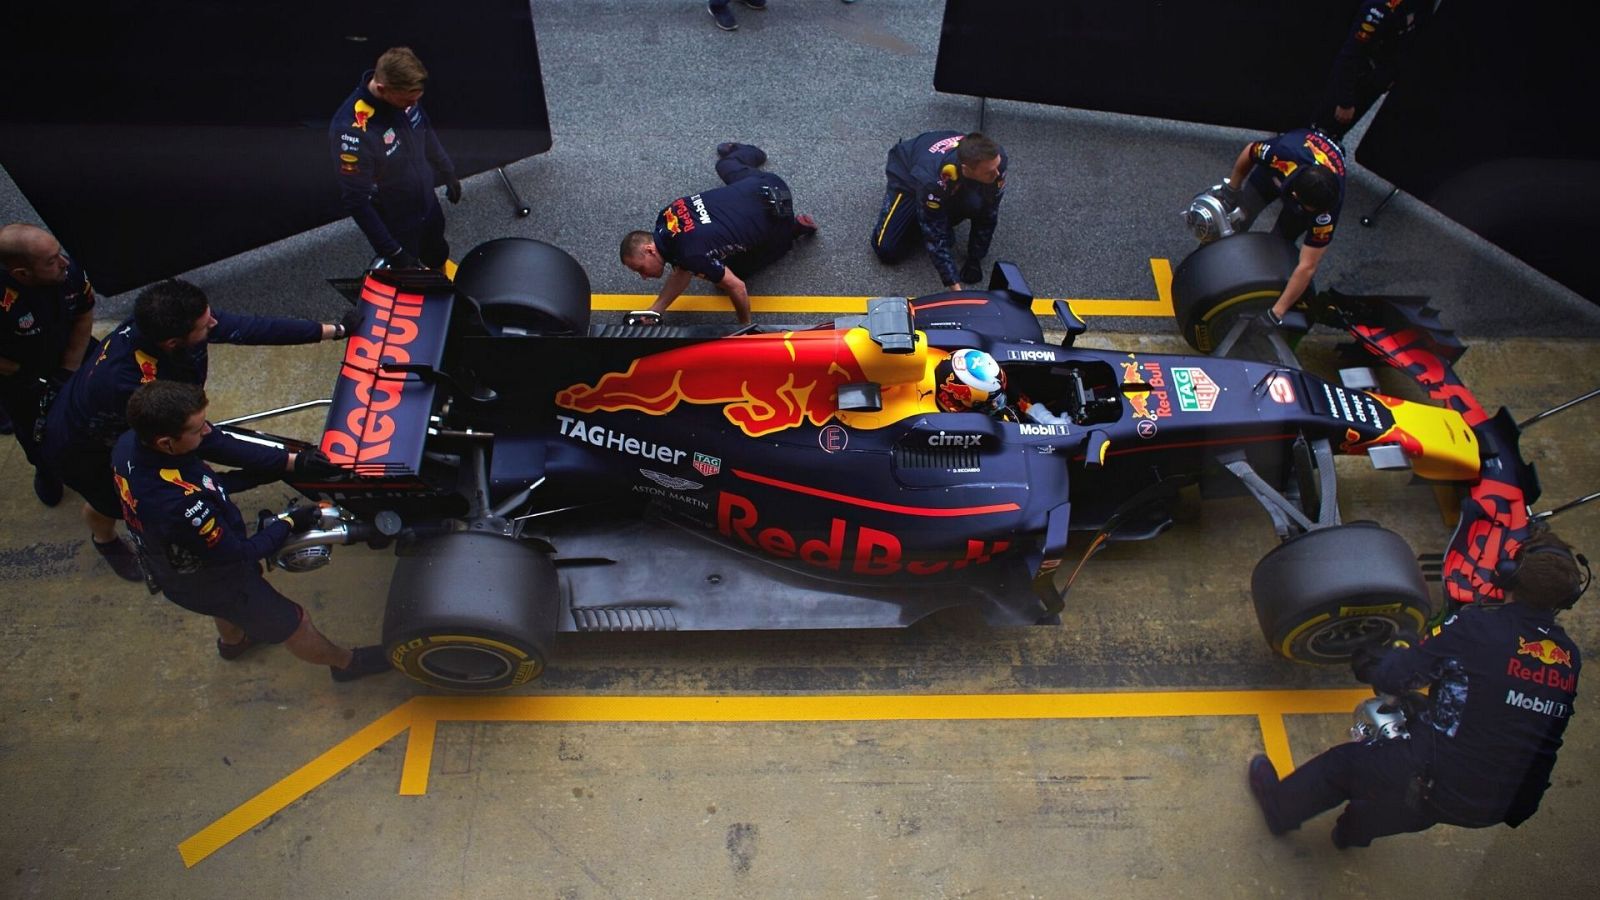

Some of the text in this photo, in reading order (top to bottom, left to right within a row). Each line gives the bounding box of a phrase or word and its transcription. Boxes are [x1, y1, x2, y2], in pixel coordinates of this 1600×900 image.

[692, 199, 711, 224] Mobil
[1020, 350, 1056, 361] Mobil
[1144, 363, 1172, 417] Red Bull
[1175, 370, 1197, 409] TAG
[1191, 370, 1214, 409] HEUER
[1020, 424, 1055, 435] Mobil
[696, 455, 719, 466] TAG
[632, 485, 665, 496] ASTON
[669, 493, 709, 509] MARTIN
[1507, 657, 1575, 696] Red Bull
[1505, 689, 1553, 715] Mobil
